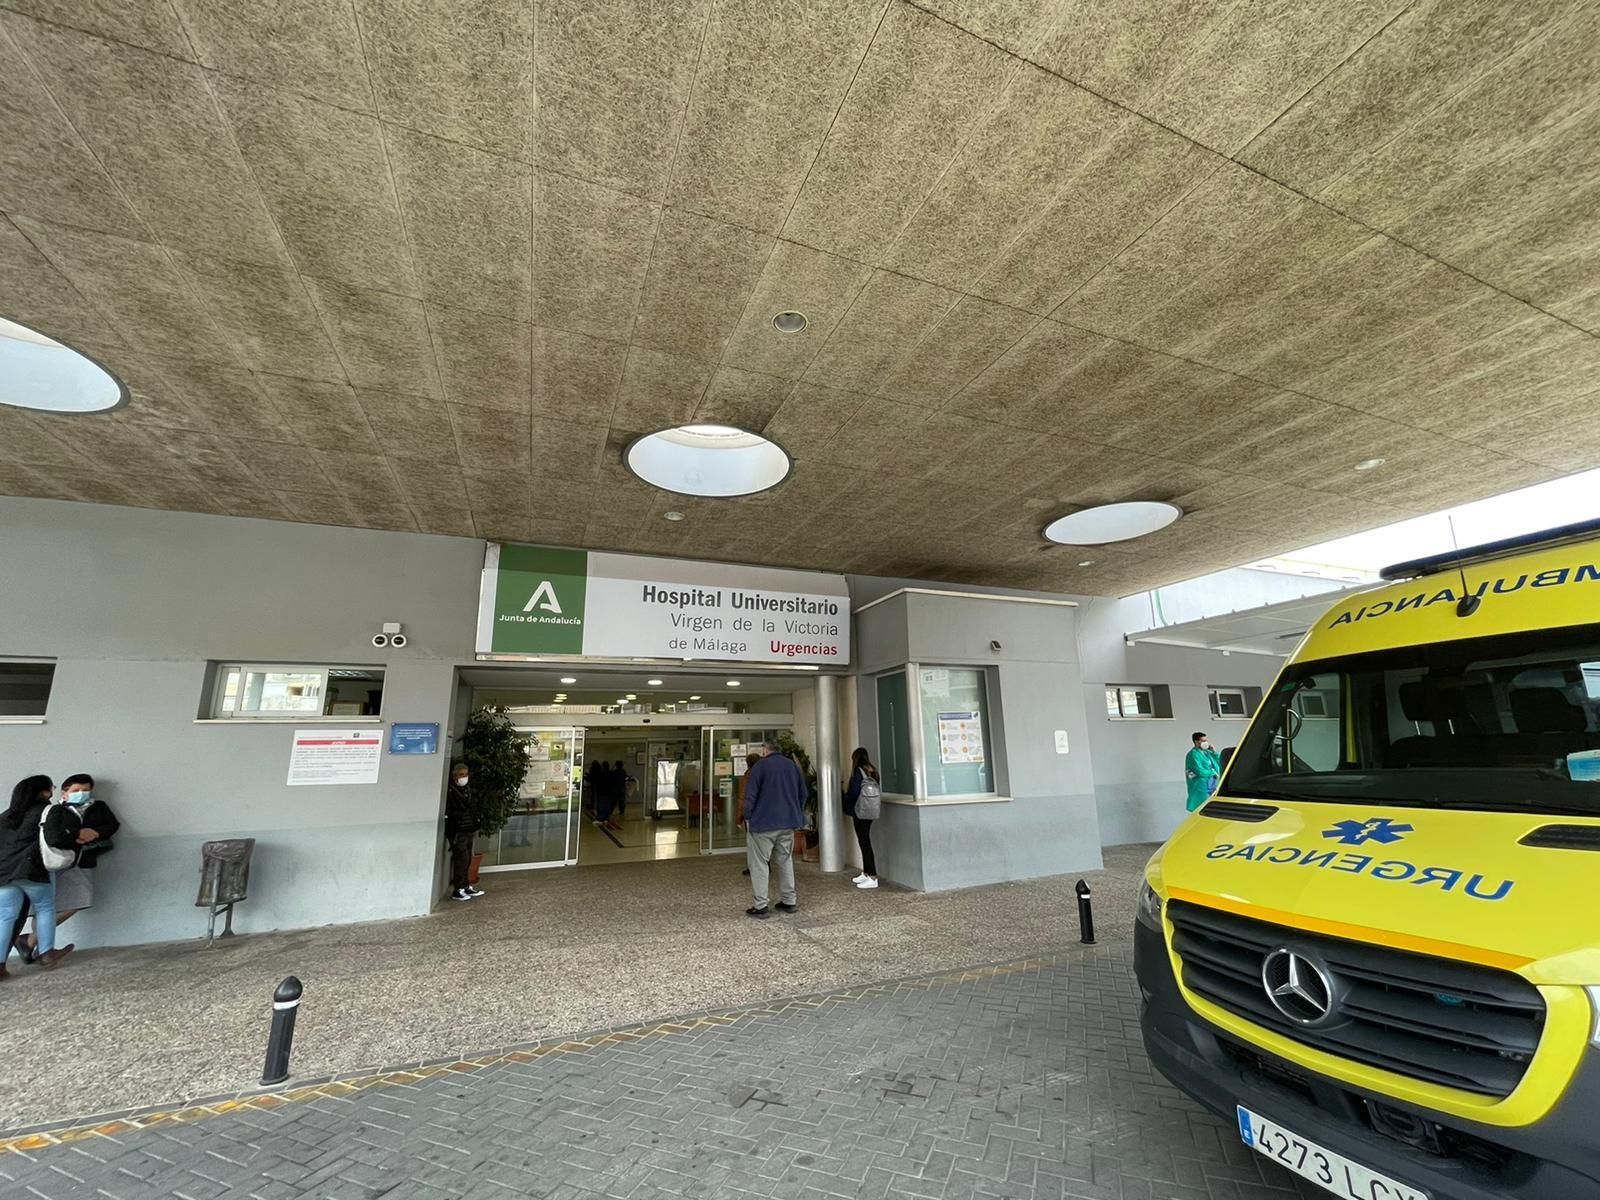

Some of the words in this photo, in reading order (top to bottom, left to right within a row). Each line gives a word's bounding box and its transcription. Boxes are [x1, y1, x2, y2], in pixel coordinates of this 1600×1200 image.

[642, 585, 721, 608] Hospital
[731, 592, 838, 616] Universitario
[499, 614, 525, 623] Junta
[527, 615, 538, 623] de
[539, 615, 581, 625] Andalucía
[670, 613, 722, 632] Virgen
[732, 617, 753, 631] de
[762, 619, 775, 632] la
[784, 620, 838, 636] Victoria
[669, 637, 688, 650] de
[693, 638, 747, 653] Málaga
[770, 641, 838, 656] Urgencias
[1258, 1124, 1333, 1187] 4273
